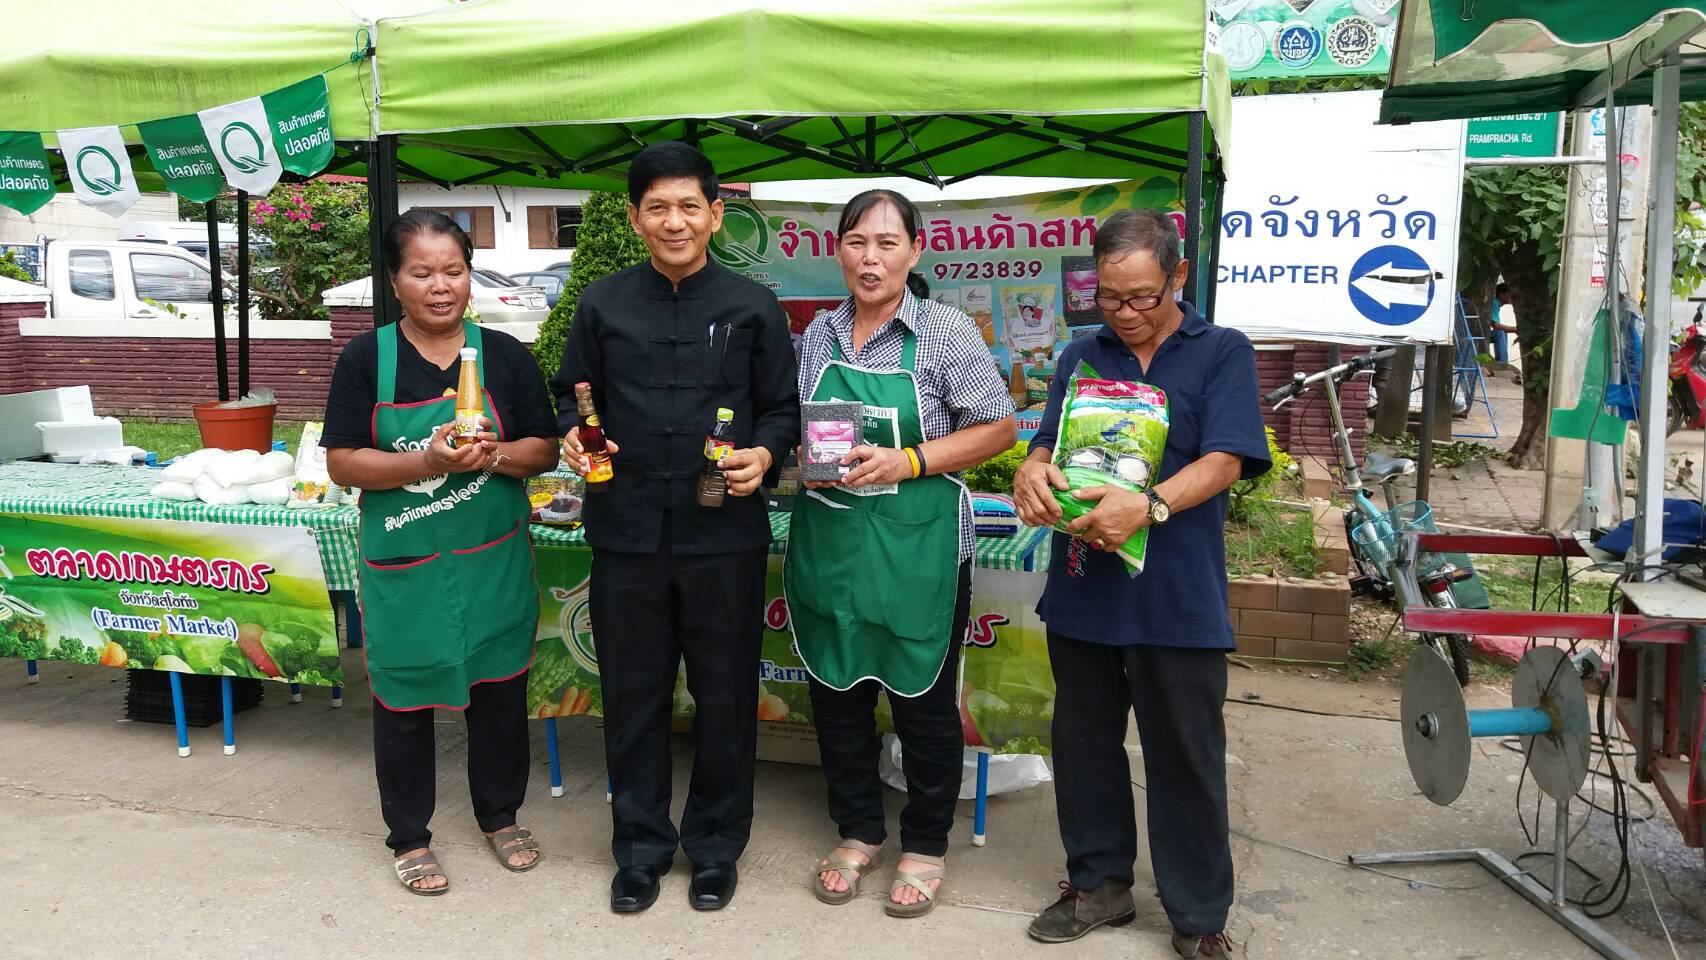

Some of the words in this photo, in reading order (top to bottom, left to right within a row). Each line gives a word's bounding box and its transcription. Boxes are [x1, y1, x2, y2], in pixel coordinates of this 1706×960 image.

[277, 107, 326, 134] สินค้าเกษตร
[284, 127, 330, 156] ปลอดภัย
[1469, 133, 1519, 144] PRAMPRACHA
[155, 144, 208, 160] สินค้าเกษตร
[165, 160, 215, 179] ปลอดภัย
[1222, 194, 1436, 241] ดจังหวัด
[934, 260, 1043, 280] 9723839
[1217, 265, 1338, 284] CHAPTER
[26, 547, 275, 594] ตลาดเกษตรกร
[120, 591, 198, 610] จังหวัดสุโขทัย
[92, 607, 160, 632] (Farmer
[166, 615, 238, 641] Market)
